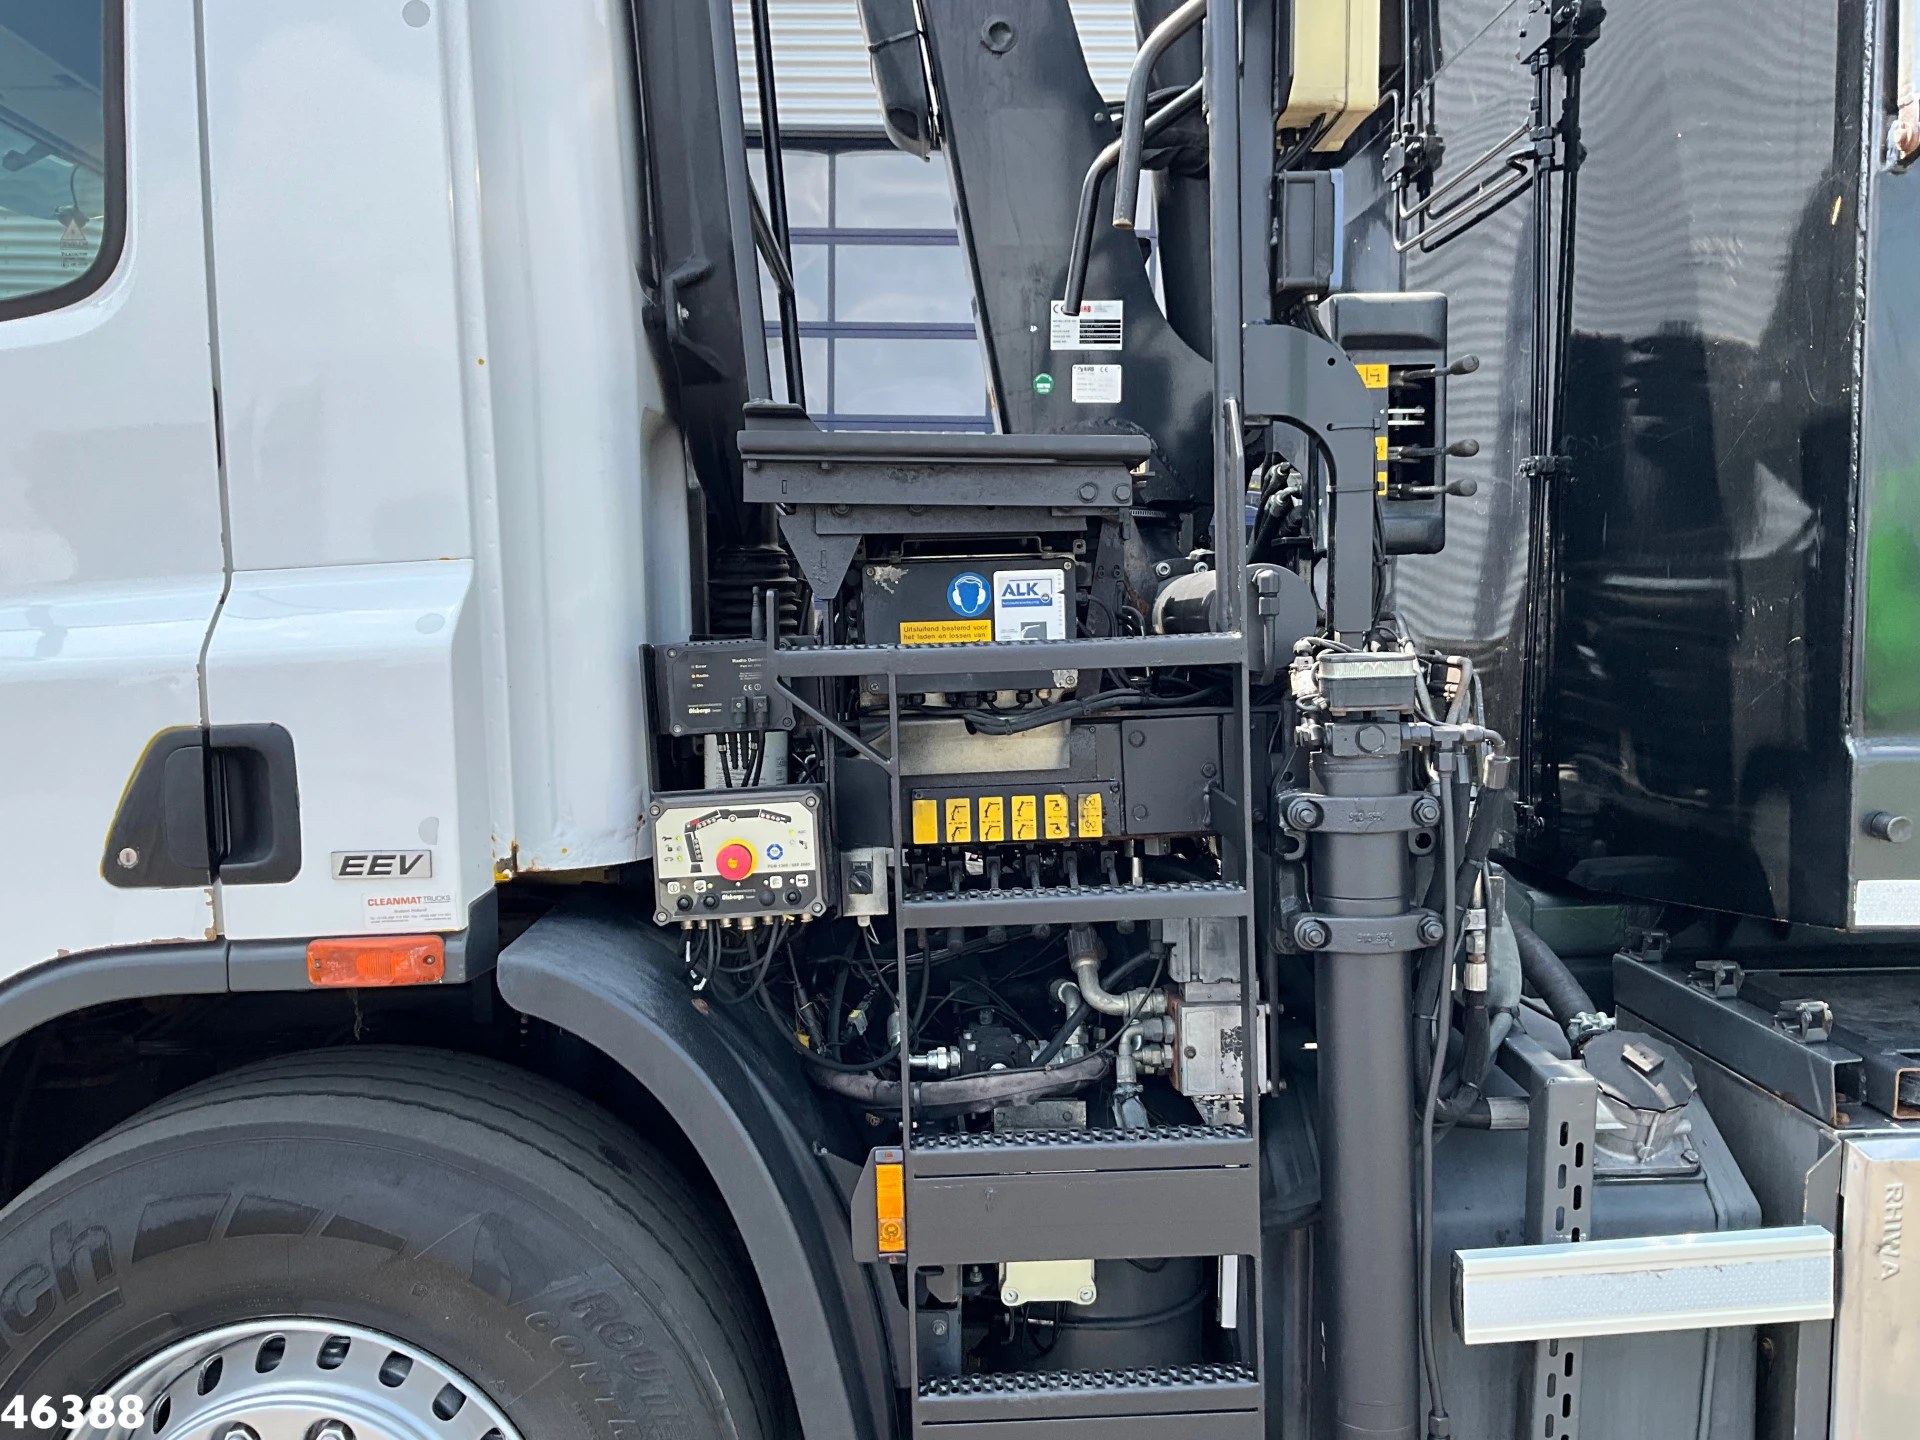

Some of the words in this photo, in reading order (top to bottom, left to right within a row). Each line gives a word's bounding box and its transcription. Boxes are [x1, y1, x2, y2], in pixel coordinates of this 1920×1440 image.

[1001, 582, 1039, 597] ALK
[903, 625, 939, 633] Uitsluitend
[338, 854, 424, 876] EEV
[367, 896, 422, 907] CLEANMAT
[423, 894, 451, 903] TRUCKS
